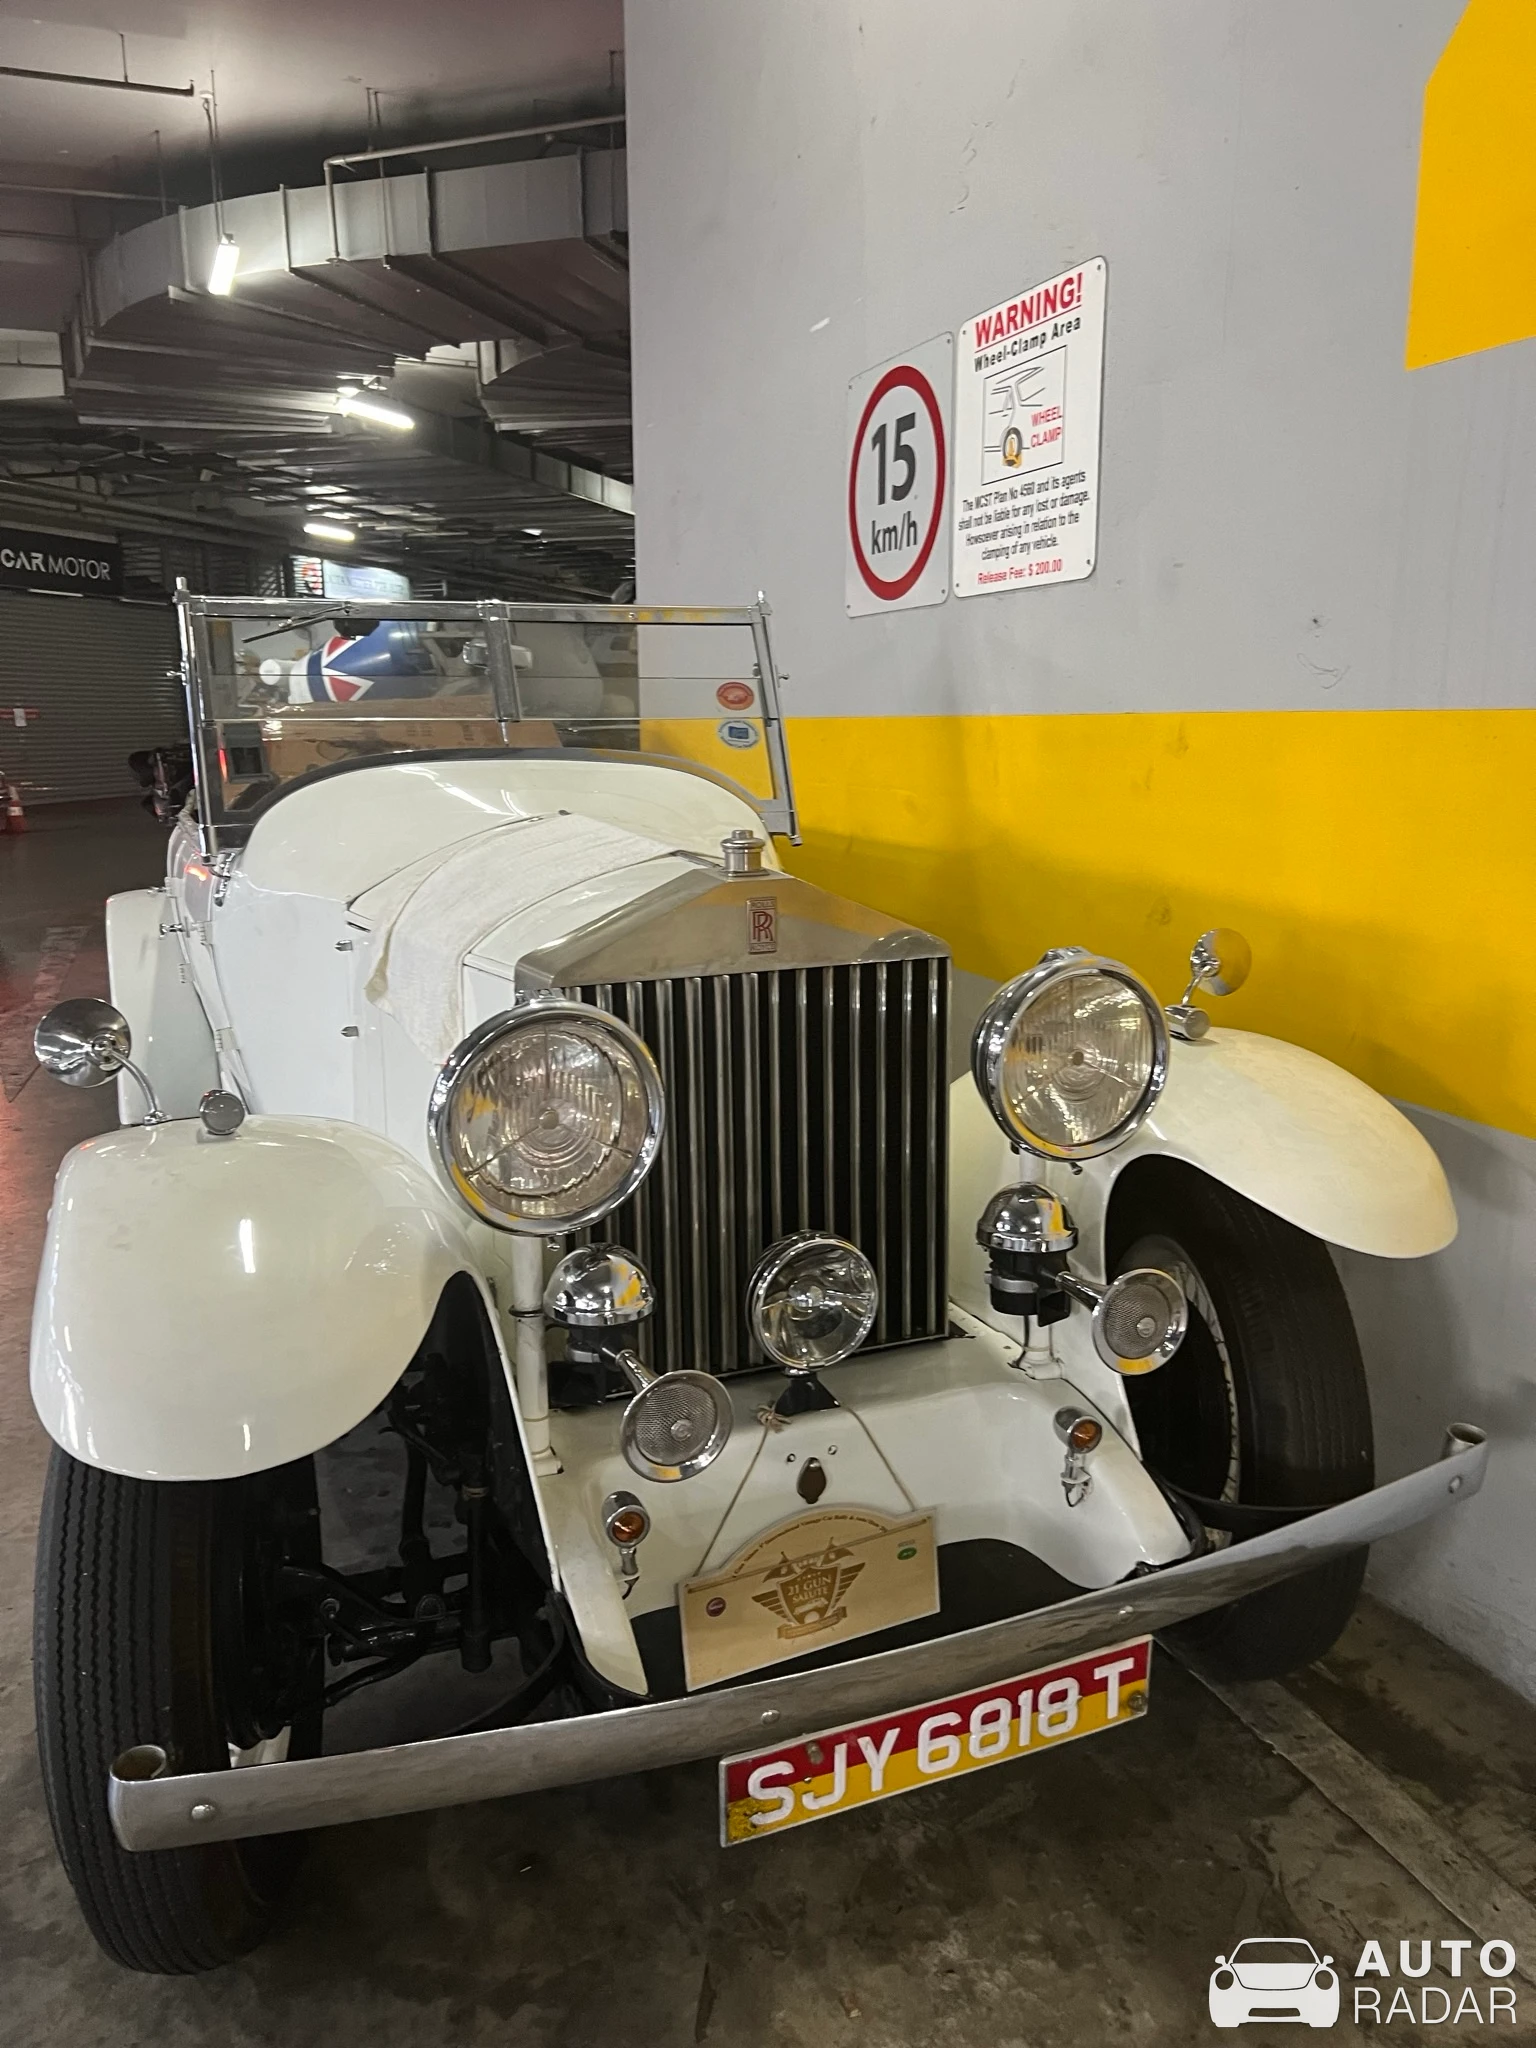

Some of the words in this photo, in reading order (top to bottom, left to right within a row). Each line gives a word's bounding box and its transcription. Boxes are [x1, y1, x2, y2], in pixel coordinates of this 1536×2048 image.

[975, 272, 1083, 348] WARNING!
[974, 331, 1047, 372] Wheel-Clamp
[1051, 317, 1081, 340] Area
[1031, 405, 1062, 427] WHEEL
[1031, 426, 1062, 448] CLAMP
[871, 412, 916, 505] 15
[962, 499, 973, 512] The
[993, 491, 1008, 504] Plan
[1036, 477, 1050, 493] and
[1061, 470, 1086, 490] agents
[958, 516, 973, 531] shall
[974, 514, 984, 526] not
[985, 512, 992, 525] be
[993, 507, 1010, 523] liable
[1011, 504, 1022, 519] for
[1022, 503, 1035, 517] any
[1050, 498, 1059, 509] or
[1000, 523, 1022, 538] arising
[1023, 521, 1030, 534] in
[1030, 515, 1057, 532] relation
[1058, 514, 1066, 526] to
[1067, 510, 1080, 525] the
[871, 511, 918, 555] km/h
[0, 548, 47, 572] CAR
[48, 555, 111, 580] MOTOR
[982, 542, 1010, 561] clamping
[1011, 540, 1019, 555] of
[1019, 541, 1031, 555] any
[977, 571, 1007, 585] Release
[1008, 567, 1026, 580] Fee:
[1028, 563, 1034, 576] $
[1035, 559, 1063, 575] 200.00
[792, 1587, 828, 1602] SALUTE
[803, 1575, 832, 1590] GUN
[747, 1726, 901, 1828] SJY
[917, 1677, 1080, 1773] 6818
[1094, 1657, 1135, 1719] T
